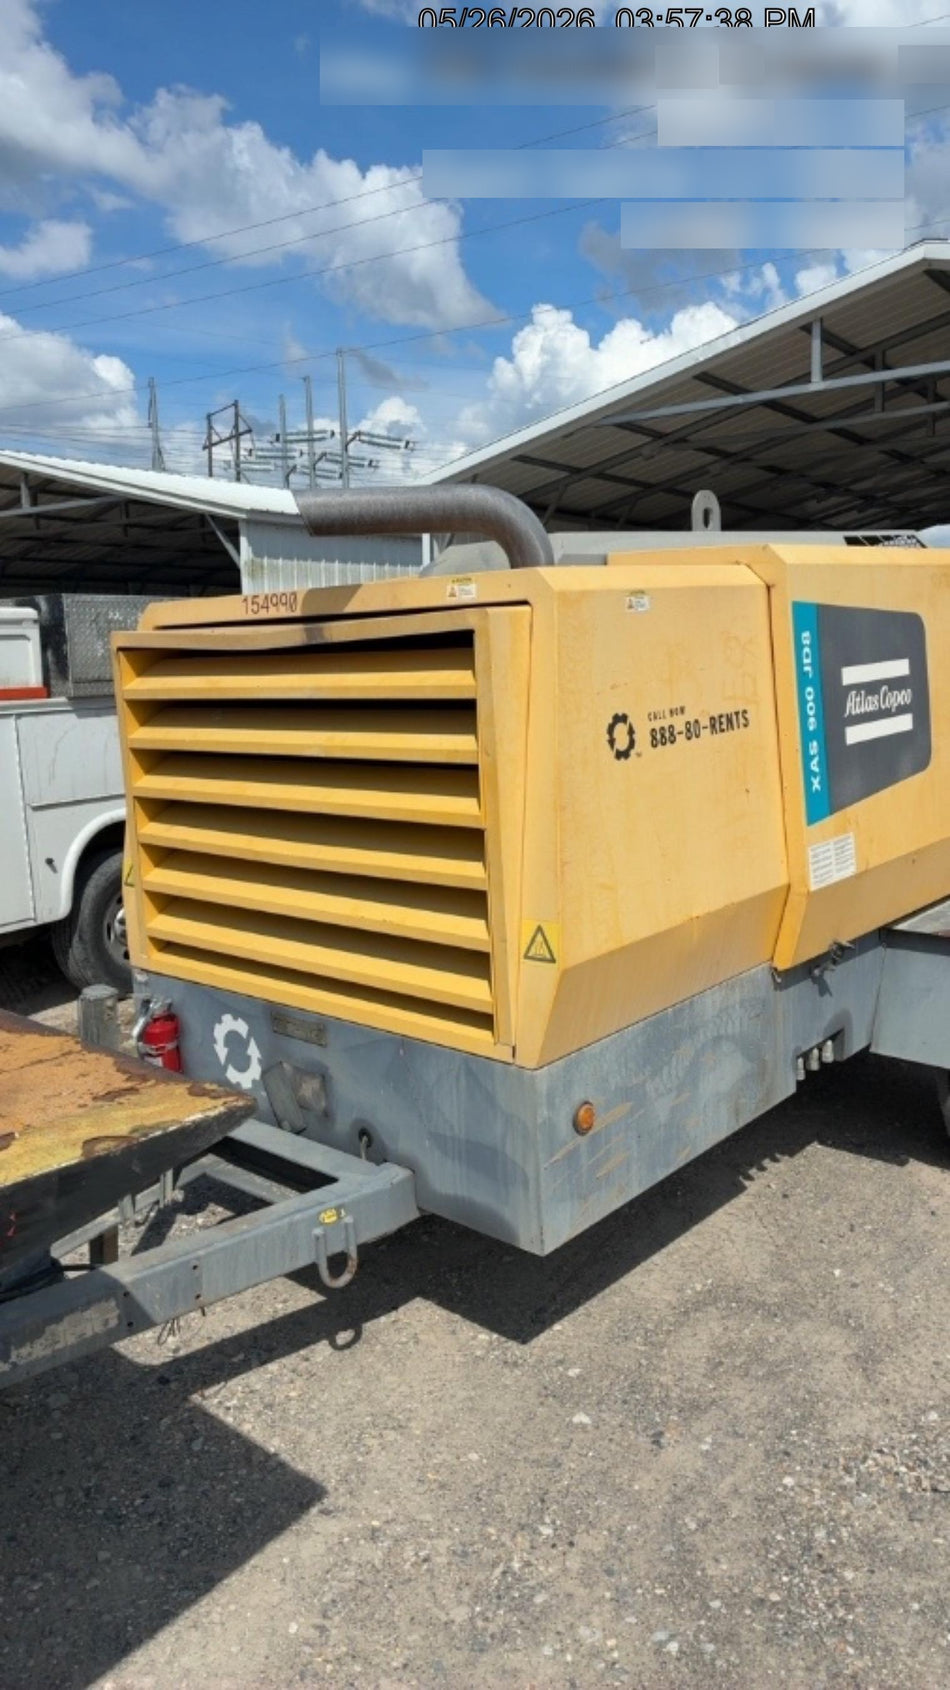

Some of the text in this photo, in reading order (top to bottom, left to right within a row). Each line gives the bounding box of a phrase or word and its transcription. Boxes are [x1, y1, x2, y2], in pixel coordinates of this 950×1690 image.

[242, 591, 297, 614] 154990
[648, 706, 685, 721] CALL NOW
[805, 687, 817, 731] 900
[845, 685, 912, 717] Atlas Copco
[650, 710, 749, 748] 888-80-RENTS
[808, 740, 821, 792] XAS
